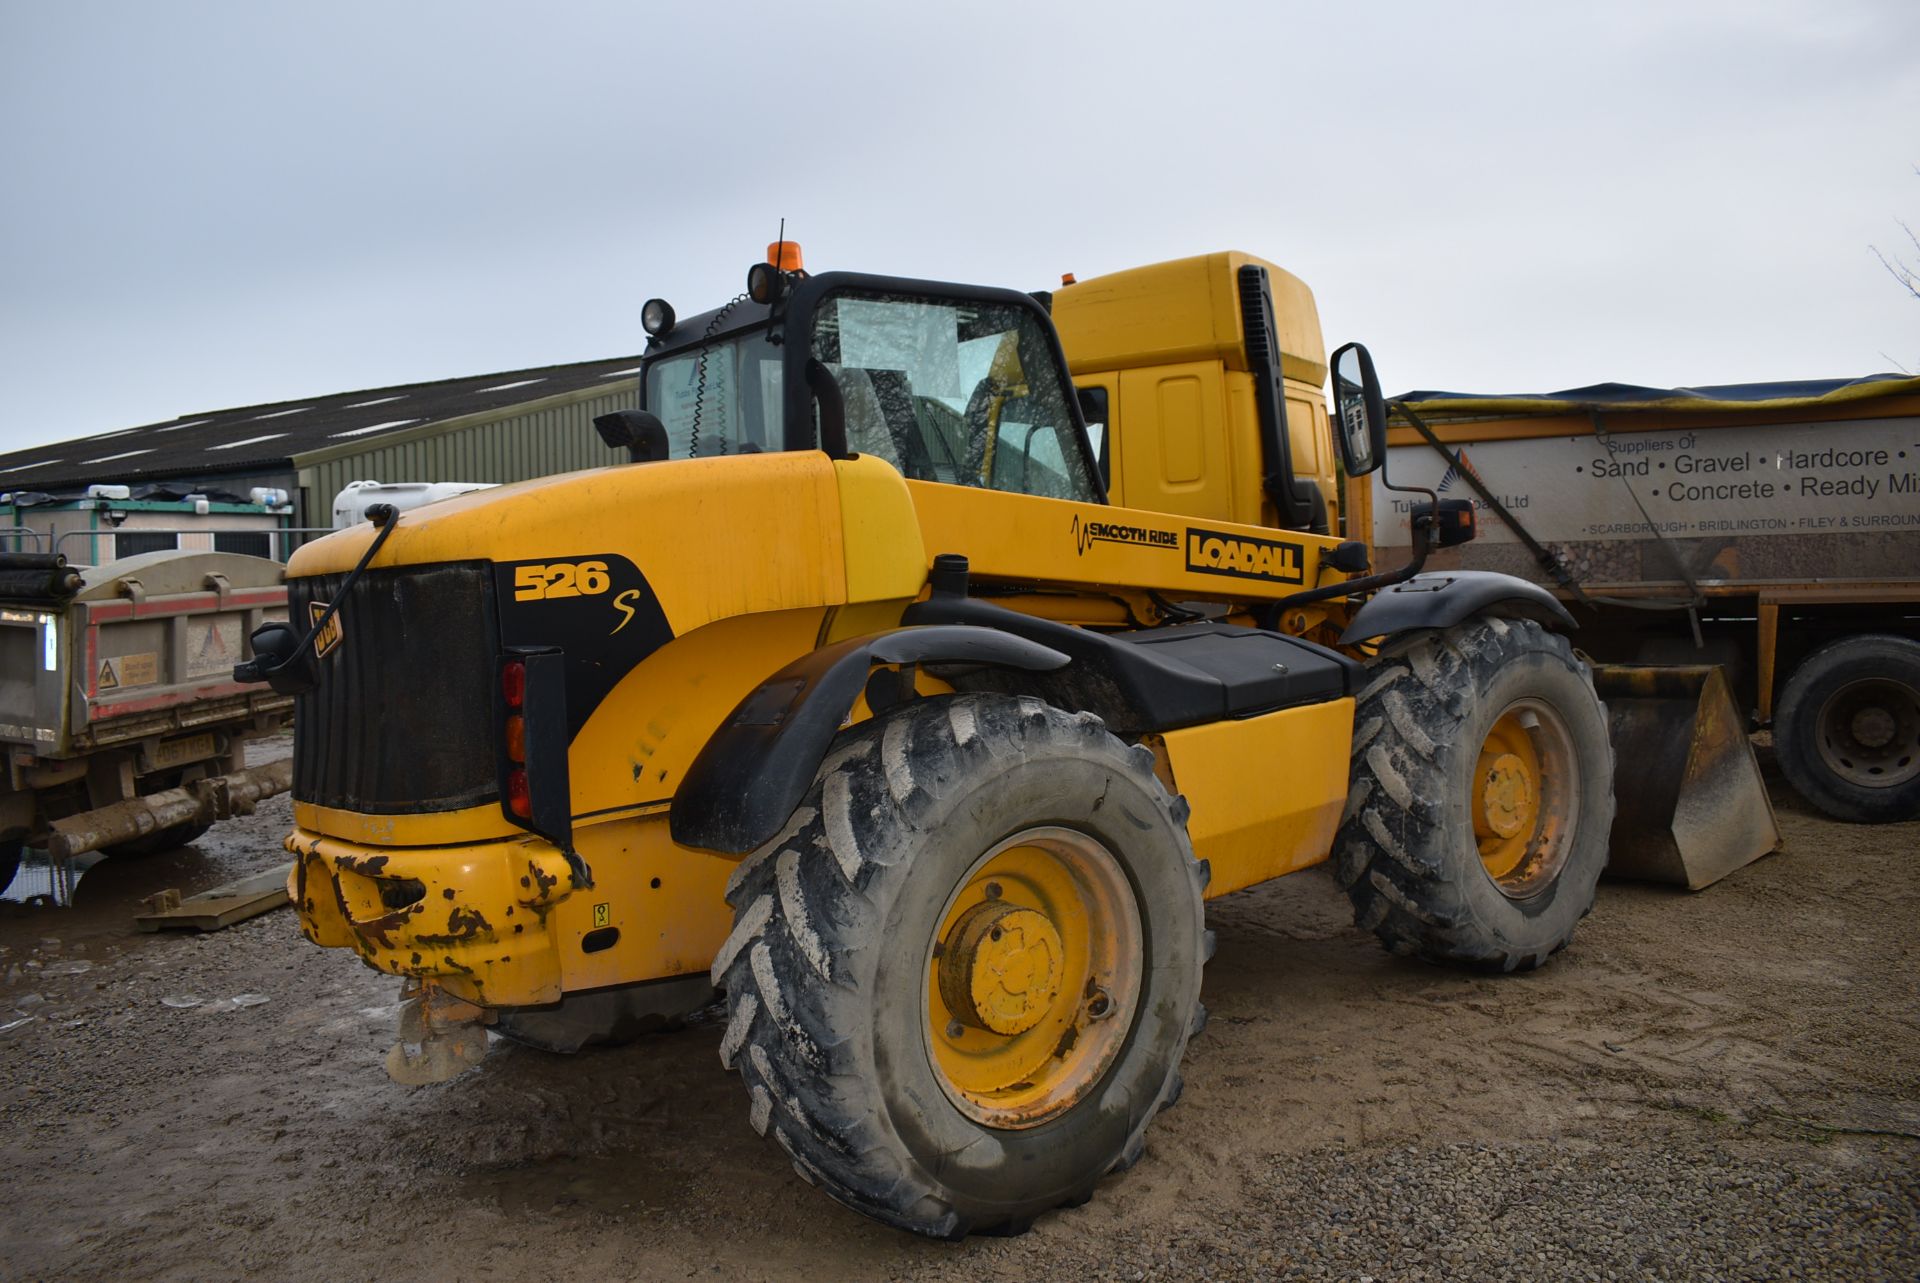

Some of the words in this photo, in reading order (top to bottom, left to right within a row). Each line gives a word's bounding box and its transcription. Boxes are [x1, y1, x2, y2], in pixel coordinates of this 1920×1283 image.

[1608, 439, 1674, 454] Suppliers
[1678, 436, 1697, 450] Of
[1591, 456, 1649, 478] Sand
[1675, 452, 1750, 474] Gravel
[1776, 448, 1888, 470] Hardcore
[1668, 480, 1775, 501] Concrete
[1801, 475, 1880, 499] Ready
[1505, 495, 1529, 509] Ltd
[1089, 522, 1147, 543] SMOOTH
[1149, 529, 1178, 546] RIDE
[1589, 521, 1688, 534] SCARBOROUGH
[1698, 518, 1787, 531] BRIDLINGTON
[1799, 516, 1836, 528] FILEY
[1839, 516, 1849, 527] &
[1189, 534, 1301, 579] LOADALL
[514, 561, 611, 602] 526
